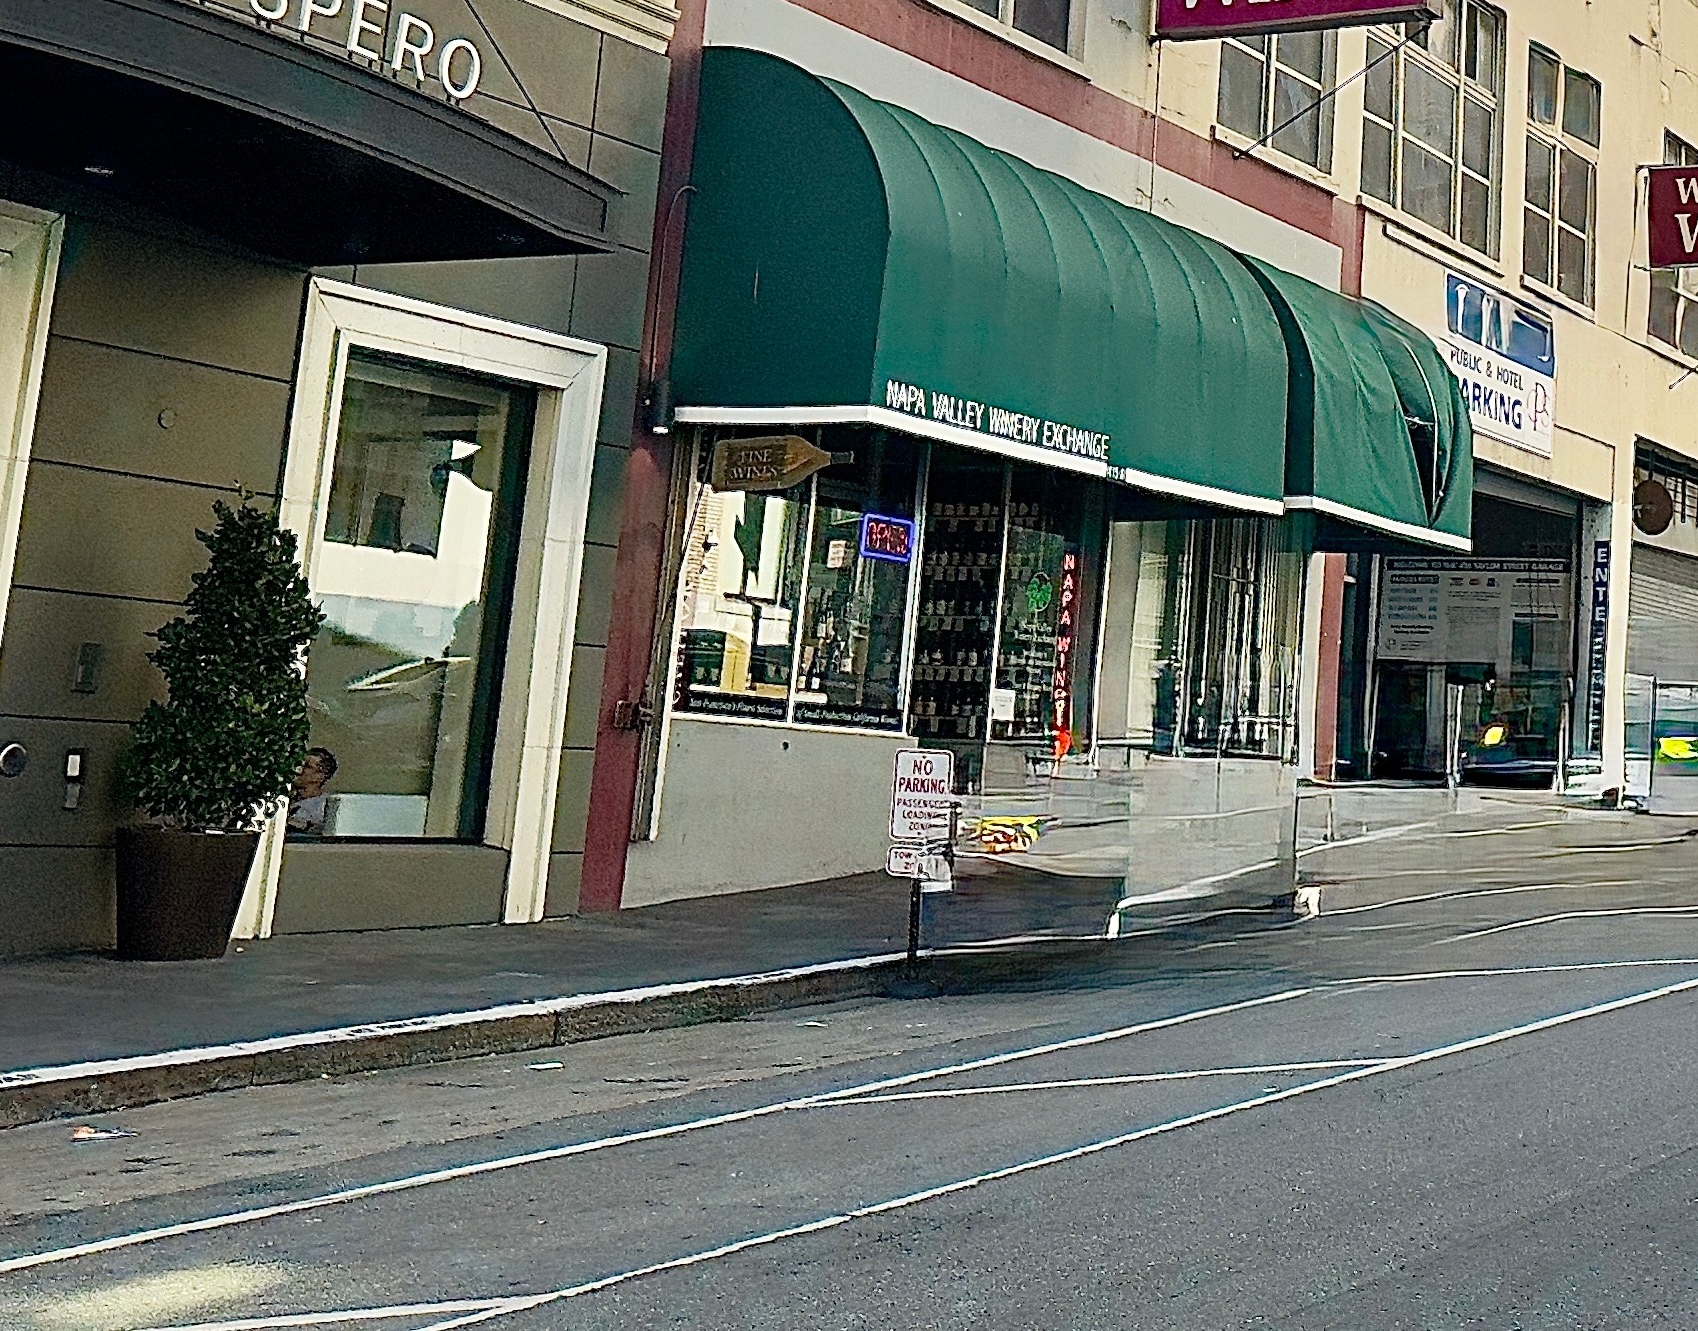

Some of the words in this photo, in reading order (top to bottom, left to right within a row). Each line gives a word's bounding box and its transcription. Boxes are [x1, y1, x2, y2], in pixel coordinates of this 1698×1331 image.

[1450, 347, 1482, 375] PUBLIC
[1486, 360, 1493, 378] &
[1496, 365, 1524, 391] HOTEL
[886, 379, 926, 416] NAPA
[932, 391, 985, 430] VALLEY
[988, 406, 1041, 443] WINERY
[1042, 421, 1110, 460] EXCHANGE
[1461, 378, 1523, 430] ARKING
[1060, 553, 1075, 626] NAPA
[898, 777, 946, 794] PARKING
[912, 759, 934, 776] NO
[897, 797, 944, 808] PASSENGE
